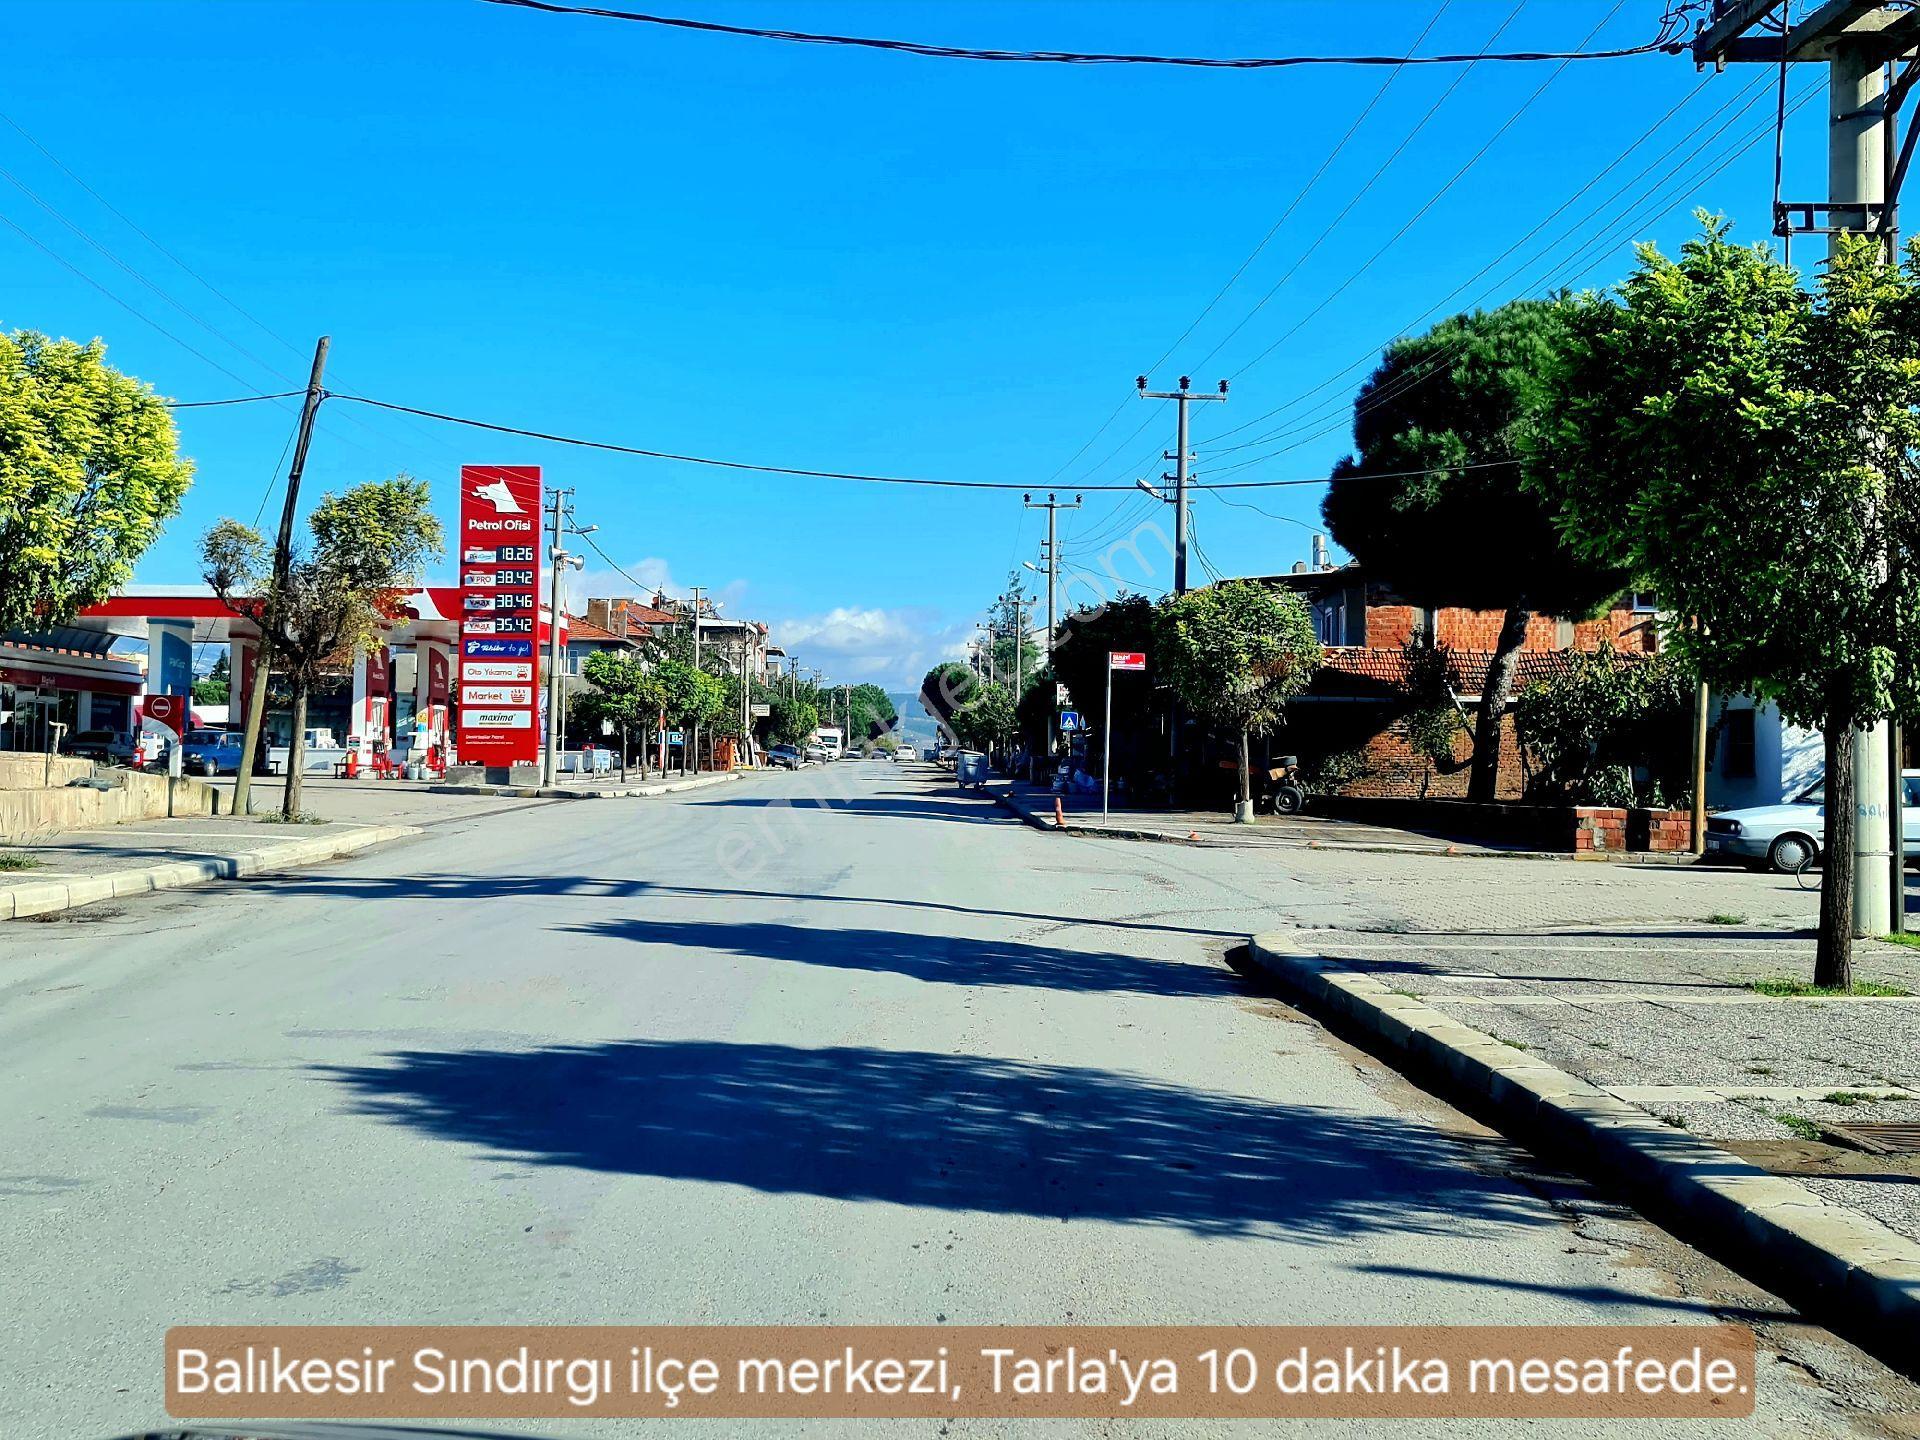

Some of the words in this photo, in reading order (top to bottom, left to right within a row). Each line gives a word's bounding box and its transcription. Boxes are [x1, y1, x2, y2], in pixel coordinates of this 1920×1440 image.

[469, 519, 502, 531] Petrol
[505, 519, 531, 531] Ofisi
[502, 547, 533, 561] 18.26
[497, 570, 533, 584] 38.42
[496, 594, 533, 608] 38.46
[496, 617, 532, 631] 35.42
[467, 668, 482, 676] Oto
[468, 691, 503, 700] Market
[479, 712, 514, 722] maxima
